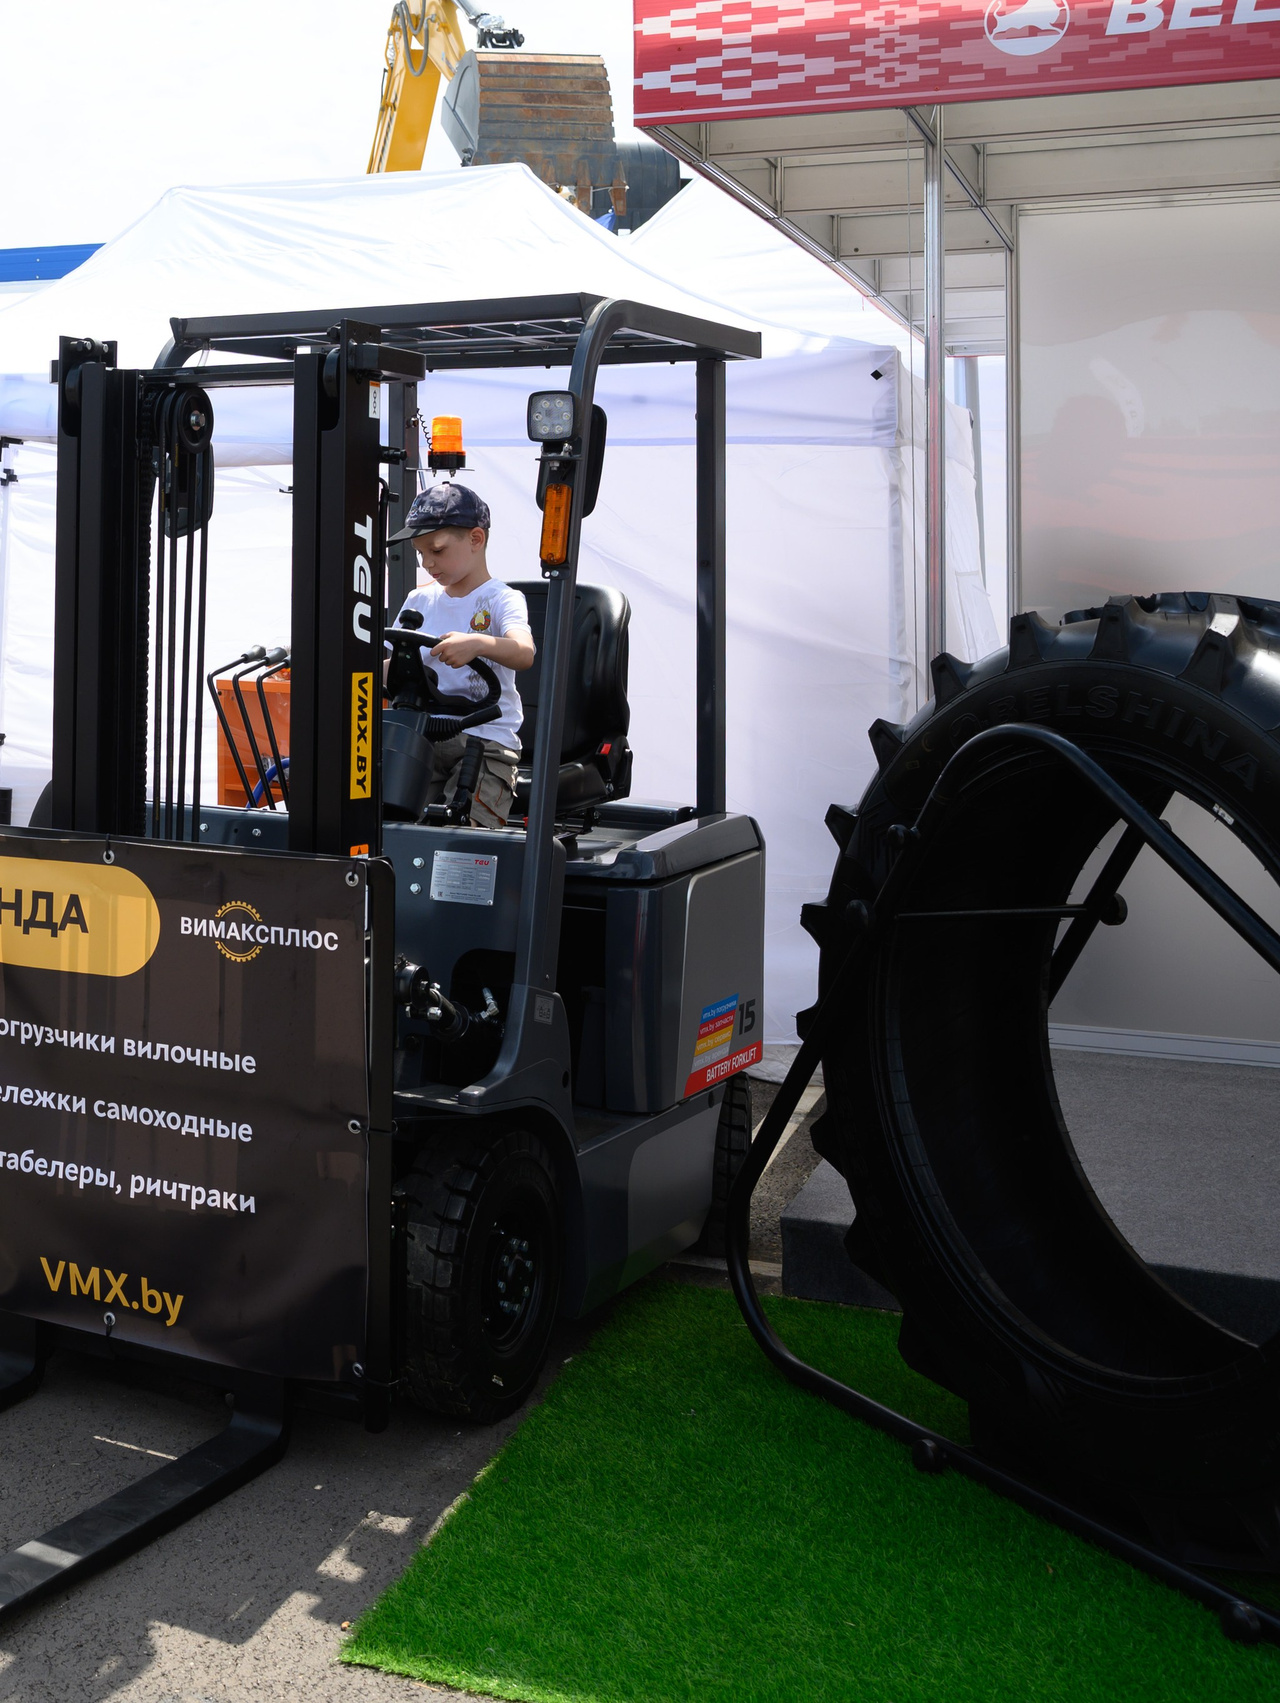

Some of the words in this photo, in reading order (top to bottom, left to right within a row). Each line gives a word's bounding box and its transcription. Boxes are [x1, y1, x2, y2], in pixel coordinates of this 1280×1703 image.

[355, 675, 369, 794] VMX.BY
[987, 684, 1261, 793] BELSHINA
[179, 916, 339, 952] ВИМАКСПЛЮС
[738, 998, 756, 1036] 15
[123, 1038, 257, 1075] вилочные
[706, 1059, 732, 1082] BATTERY
[732, 1047, 757, 1070] FORKLIFT
[93, 1099, 254, 1142] самоходные
[129, 1173, 257, 1214] ричтраки
[40, 1256, 184, 1326] VMX.by
